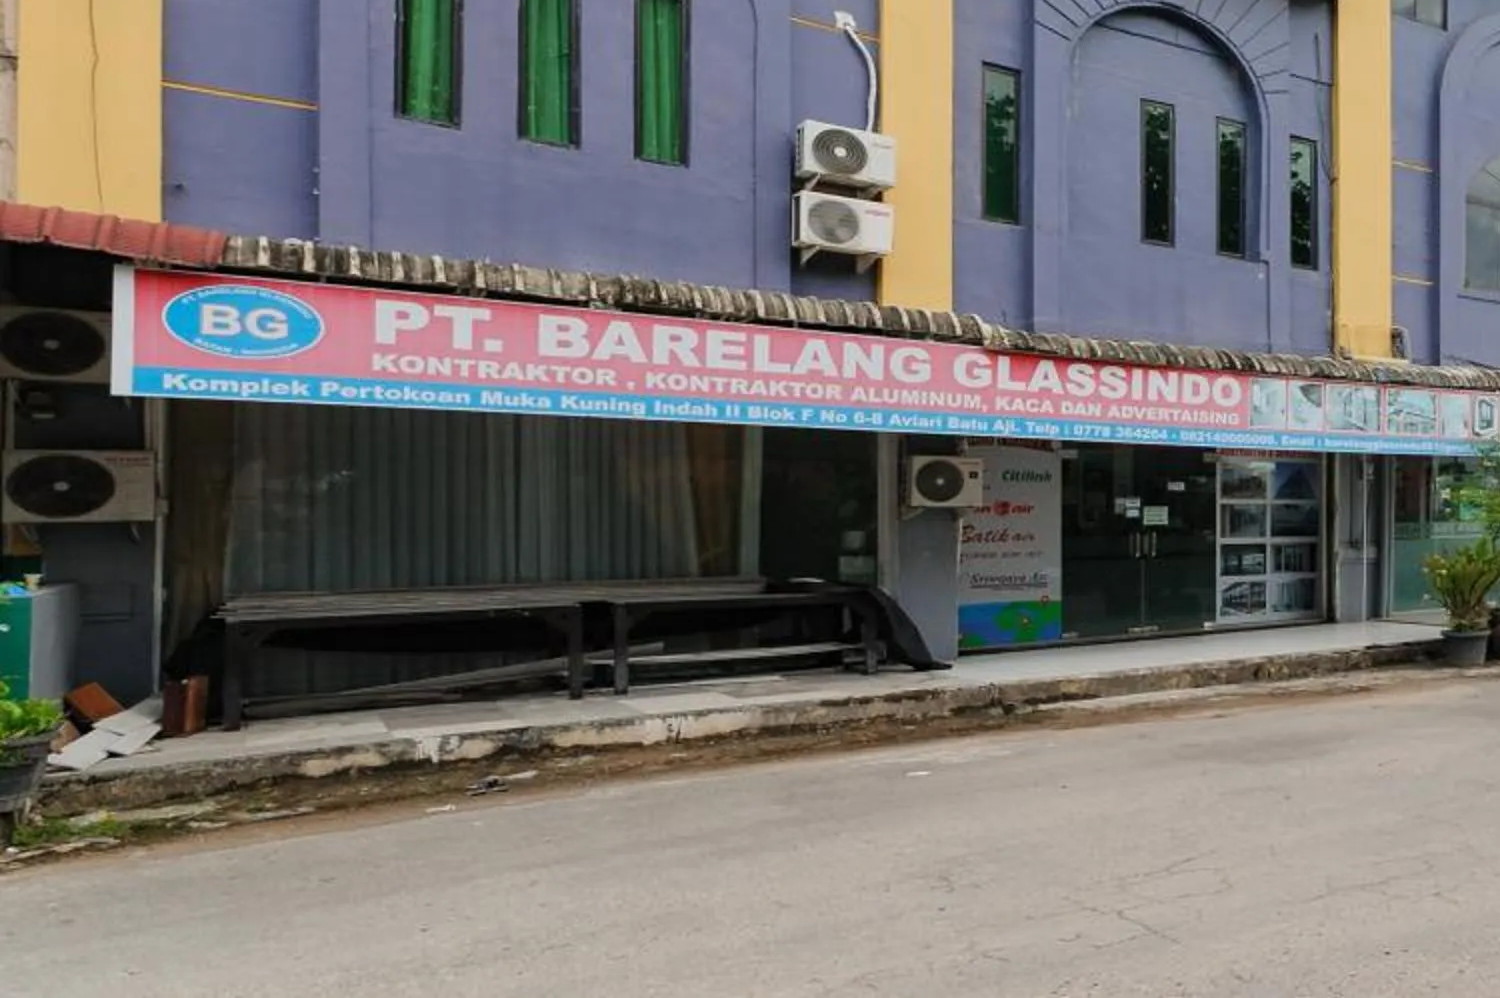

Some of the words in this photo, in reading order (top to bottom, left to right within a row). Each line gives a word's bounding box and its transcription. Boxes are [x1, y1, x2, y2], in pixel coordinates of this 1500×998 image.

[201, 304, 288, 340] BG
[374, 298, 507, 352] PT.
[539, 314, 932, 384] BARELANG
[953, 352, 1241, 408] GLASSINDO
[163, 372, 310, 397] Komplek
[320, 380, 471, 403] Pertokoan
[480, 389, 552, 409] Muka
[560, 395, 646, 416] Kuning
[654, 400, 718, 418] Indah
[747, 404, 796, 421] Blok
[802, 408, 814, 421] F
[819, 409, 847, 423] No
[646, 372, 843, 400] KONTRAKTOR
[996, 397, 1053, 414] KACA
[1060, 400, 1101, 416] DAN
[1110, 404, 1240, 425] ADVERTAISING
